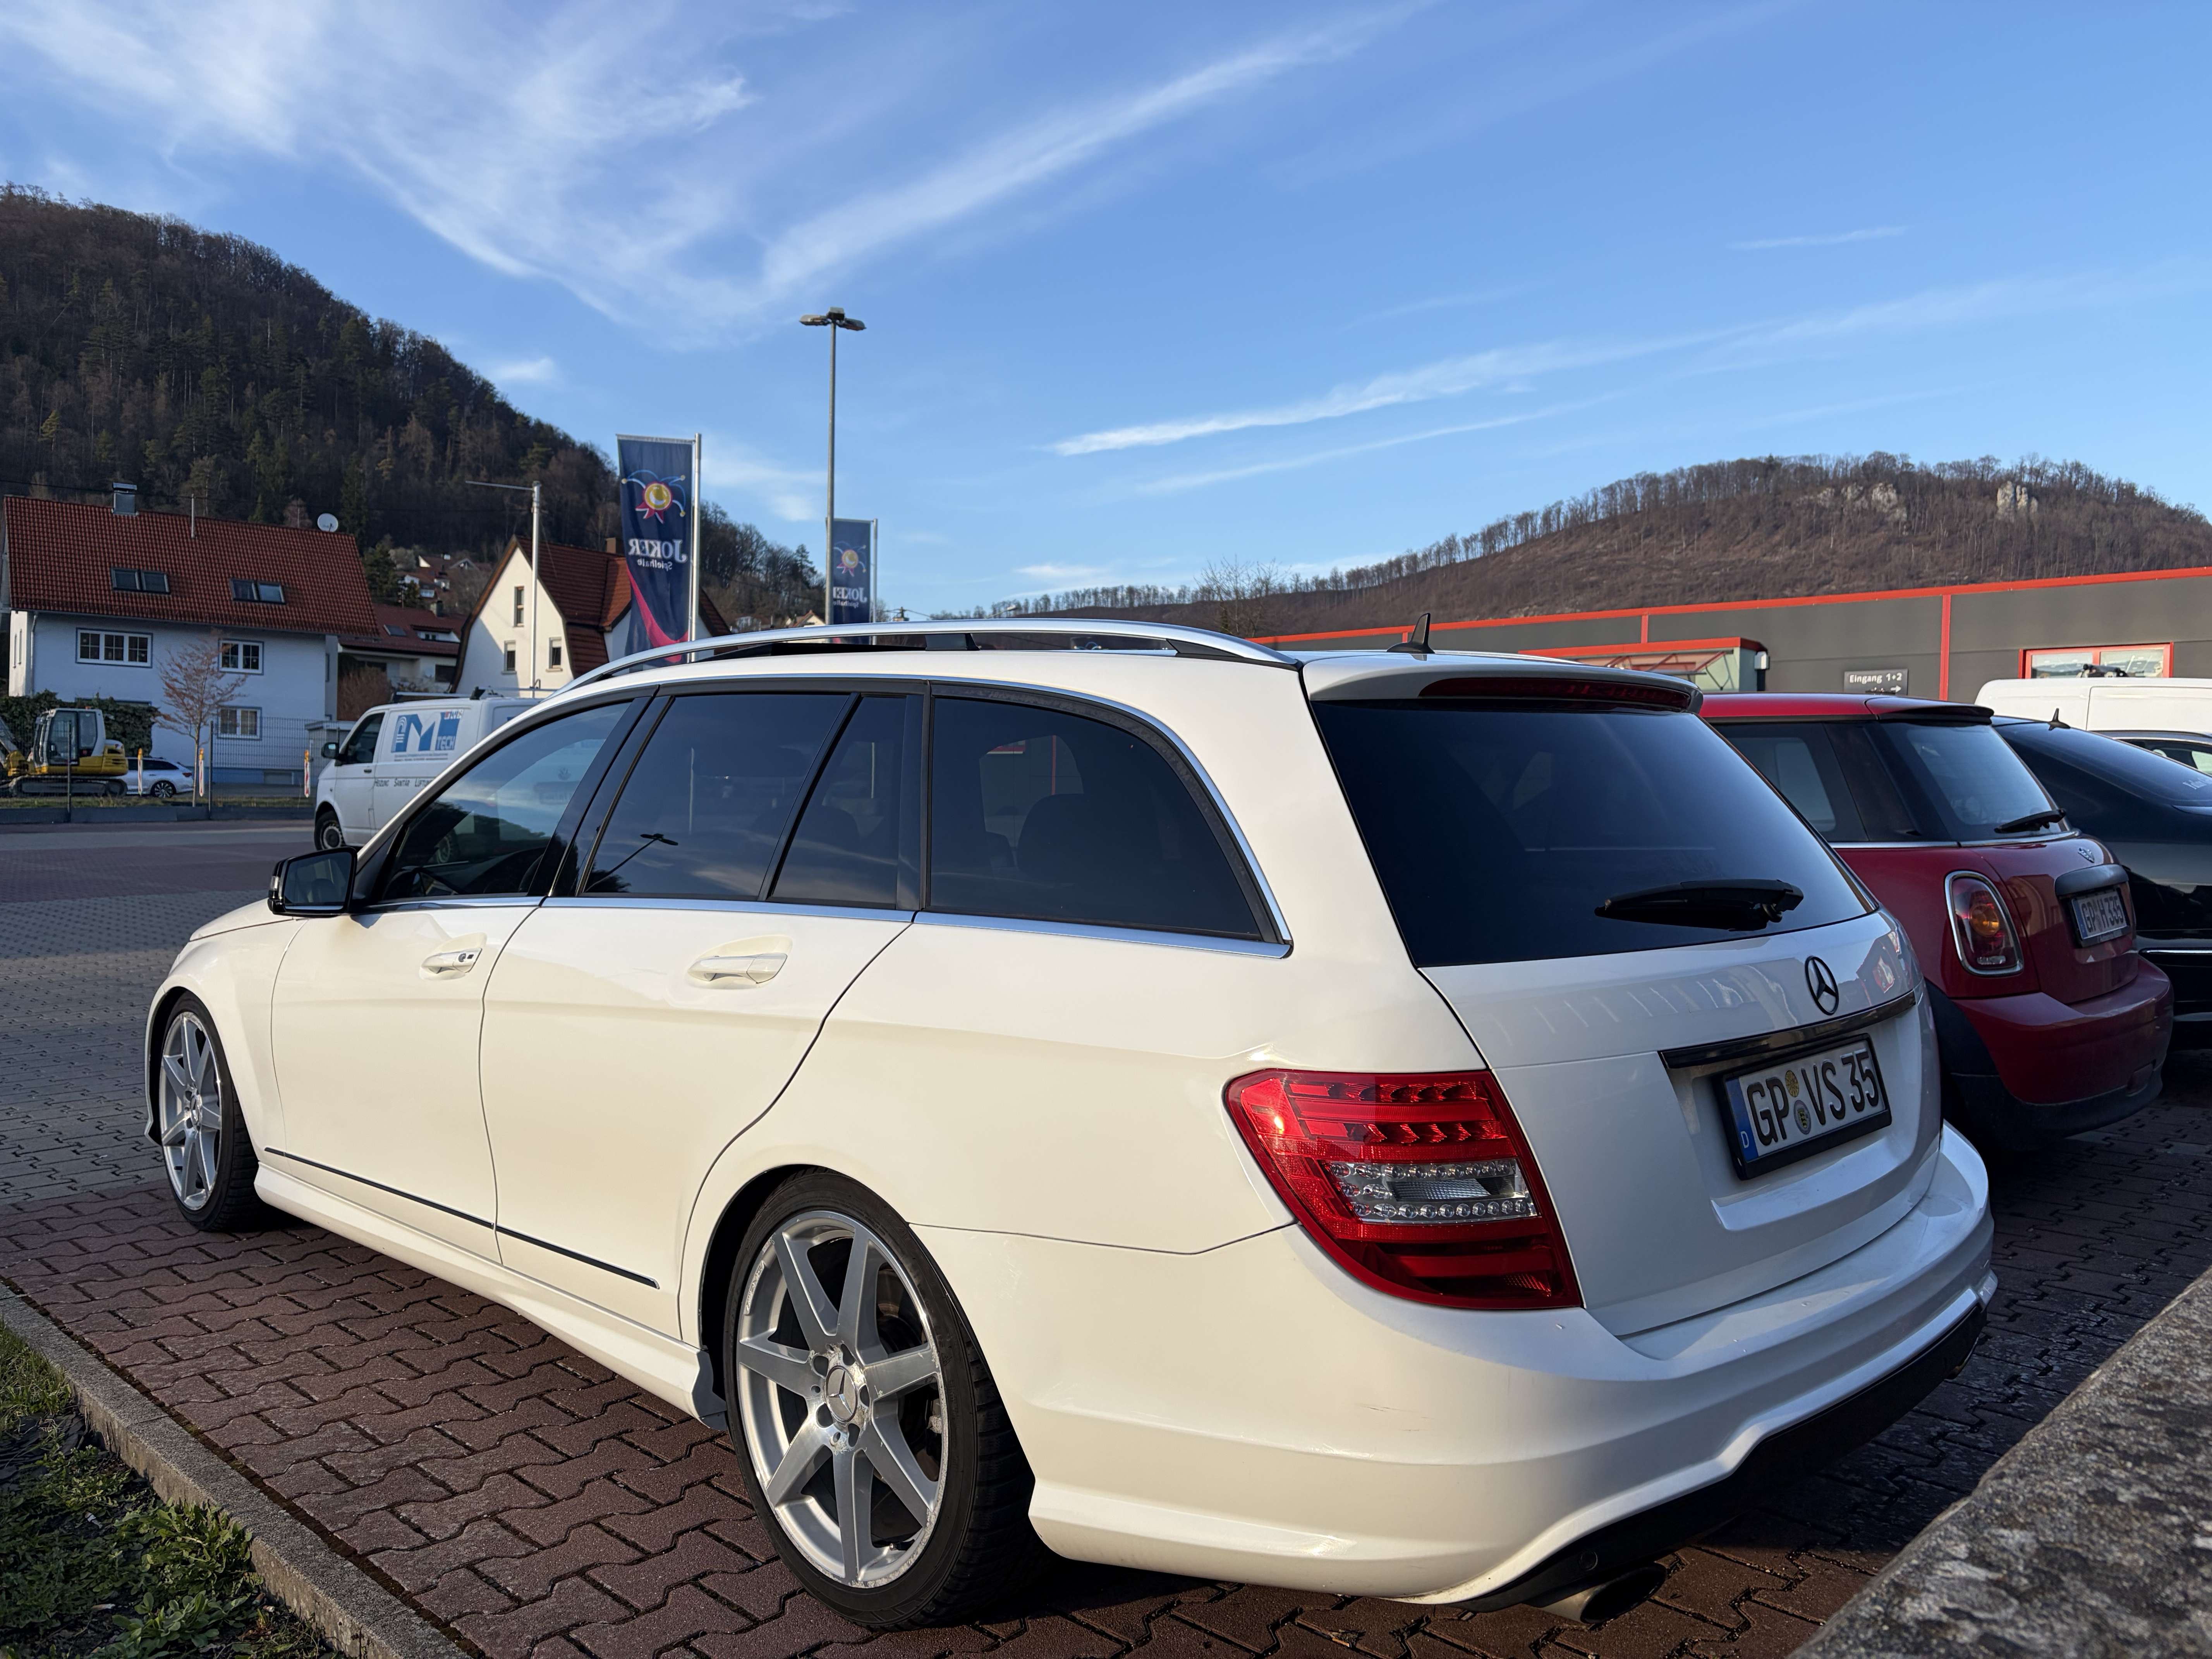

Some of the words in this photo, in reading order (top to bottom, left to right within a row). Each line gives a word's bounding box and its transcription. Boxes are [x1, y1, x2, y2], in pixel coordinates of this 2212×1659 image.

[1850, 675, 1882, 684] Eingang
[1886, 673, 1902, 682] 1+2
[2081, 902, 2096, 933] GP
[1747, 1077, 1789, 1146] GP
[1801, 1060, 1846, 1125] VS
[1840, 1048, 1879, 1112] 35
[1741, 1131, 1749, 1148] D
